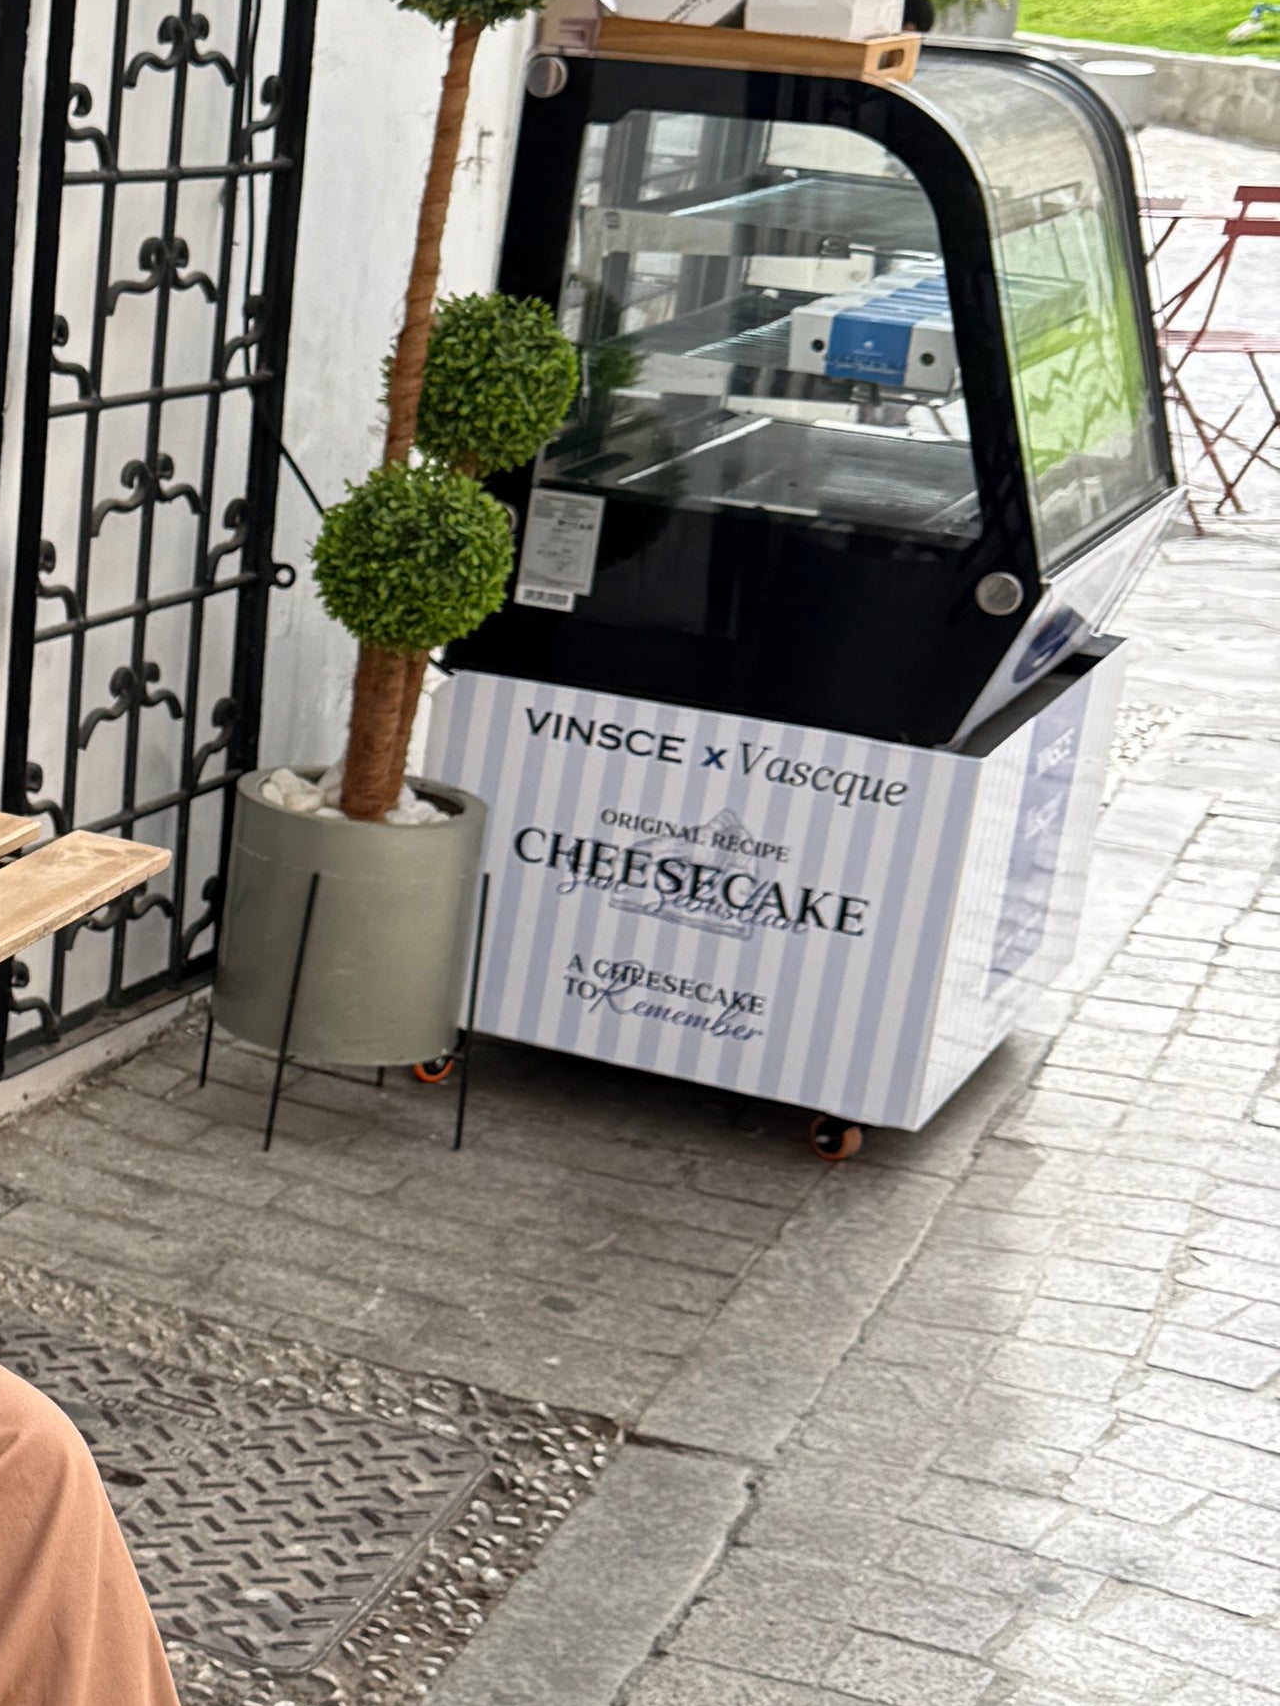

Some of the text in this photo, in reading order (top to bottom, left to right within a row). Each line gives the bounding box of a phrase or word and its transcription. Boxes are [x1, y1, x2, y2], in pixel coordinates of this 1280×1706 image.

[525, 707, 686, 764] VINSCE
[741, 741, 908, 807] Vascque
[600, 807, 790, 863] ORIGINAL RECIPE
[513, 826, 871, 937] CHEESECAKE
[564, 959, 764, 1040] TO Remember
[567, 953, 767, 1016] A CHEESECAKE
